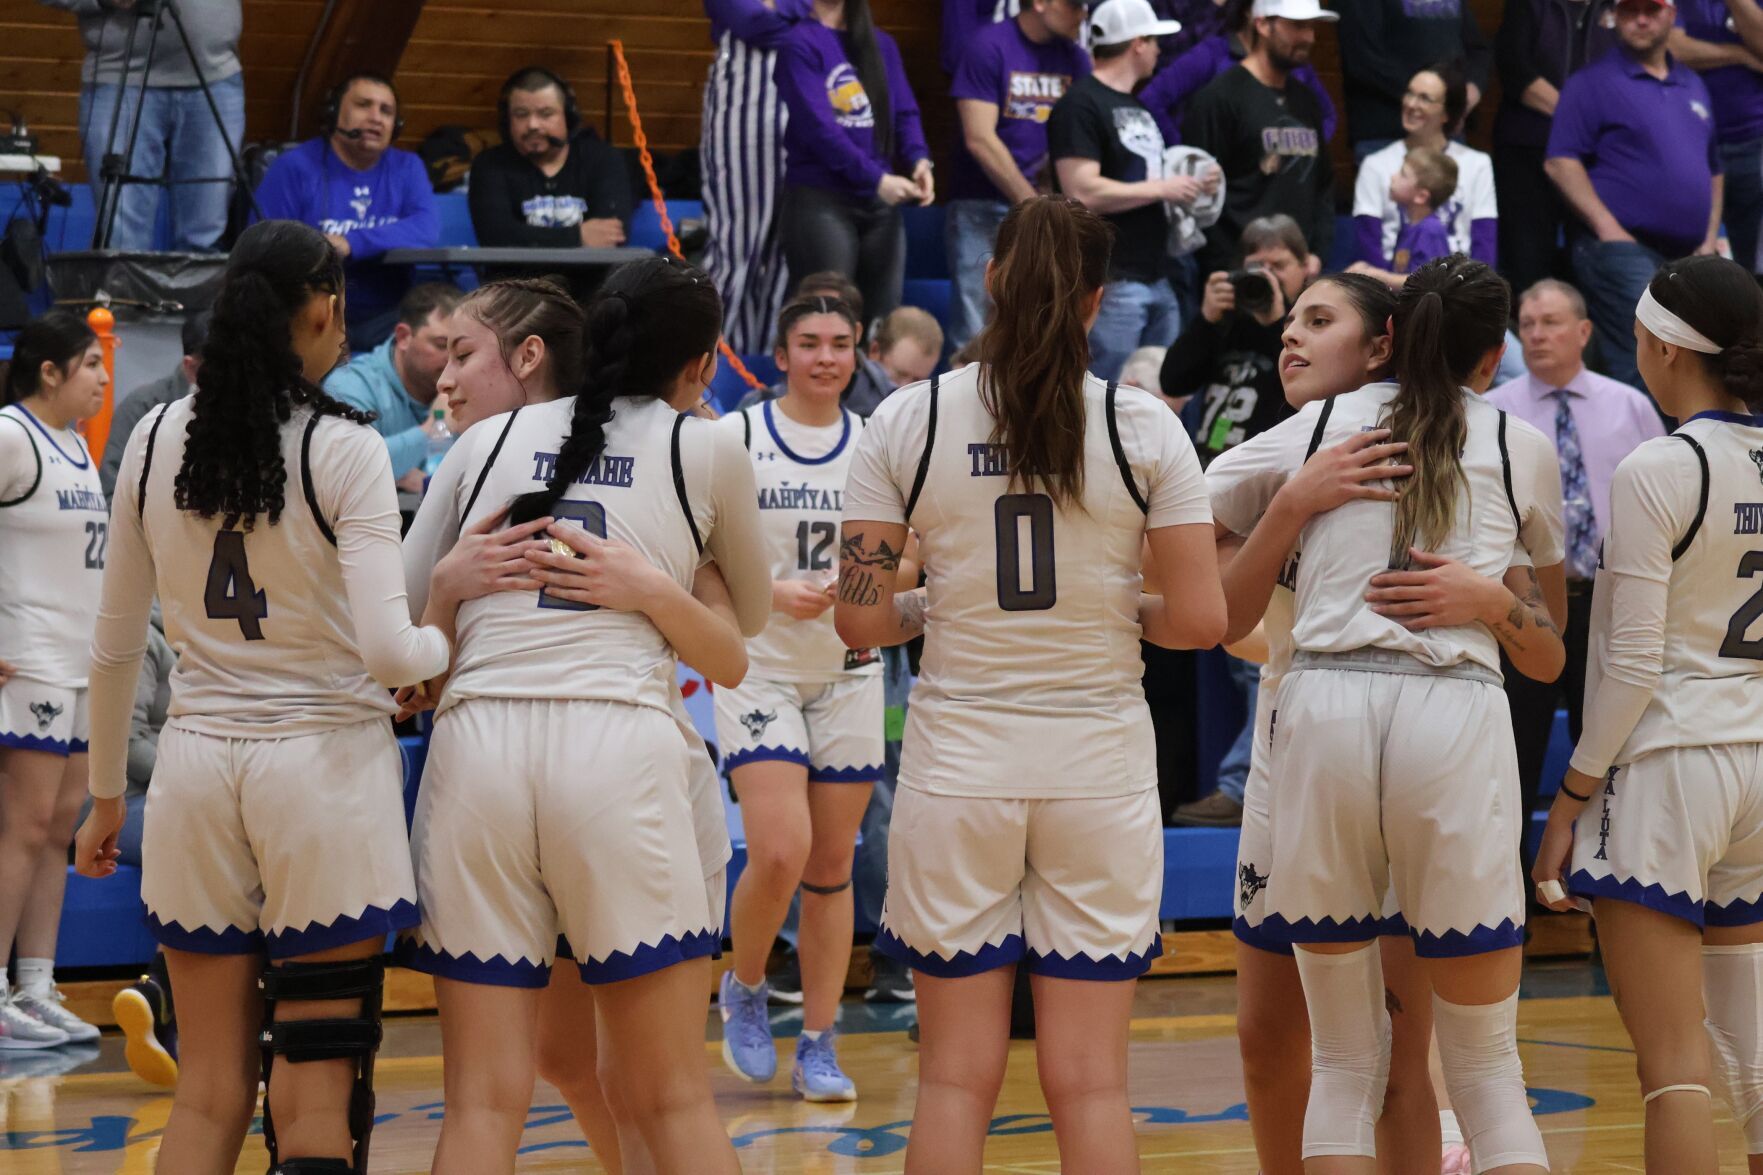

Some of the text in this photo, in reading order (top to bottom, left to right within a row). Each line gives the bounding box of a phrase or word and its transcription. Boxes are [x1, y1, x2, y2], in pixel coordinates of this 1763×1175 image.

[1011, 76, 1062, 98] STATE
[204, 530, 268, 641] 4
[796, 521, 836, 570] 12
[995, 494, 1057, 611] 0
